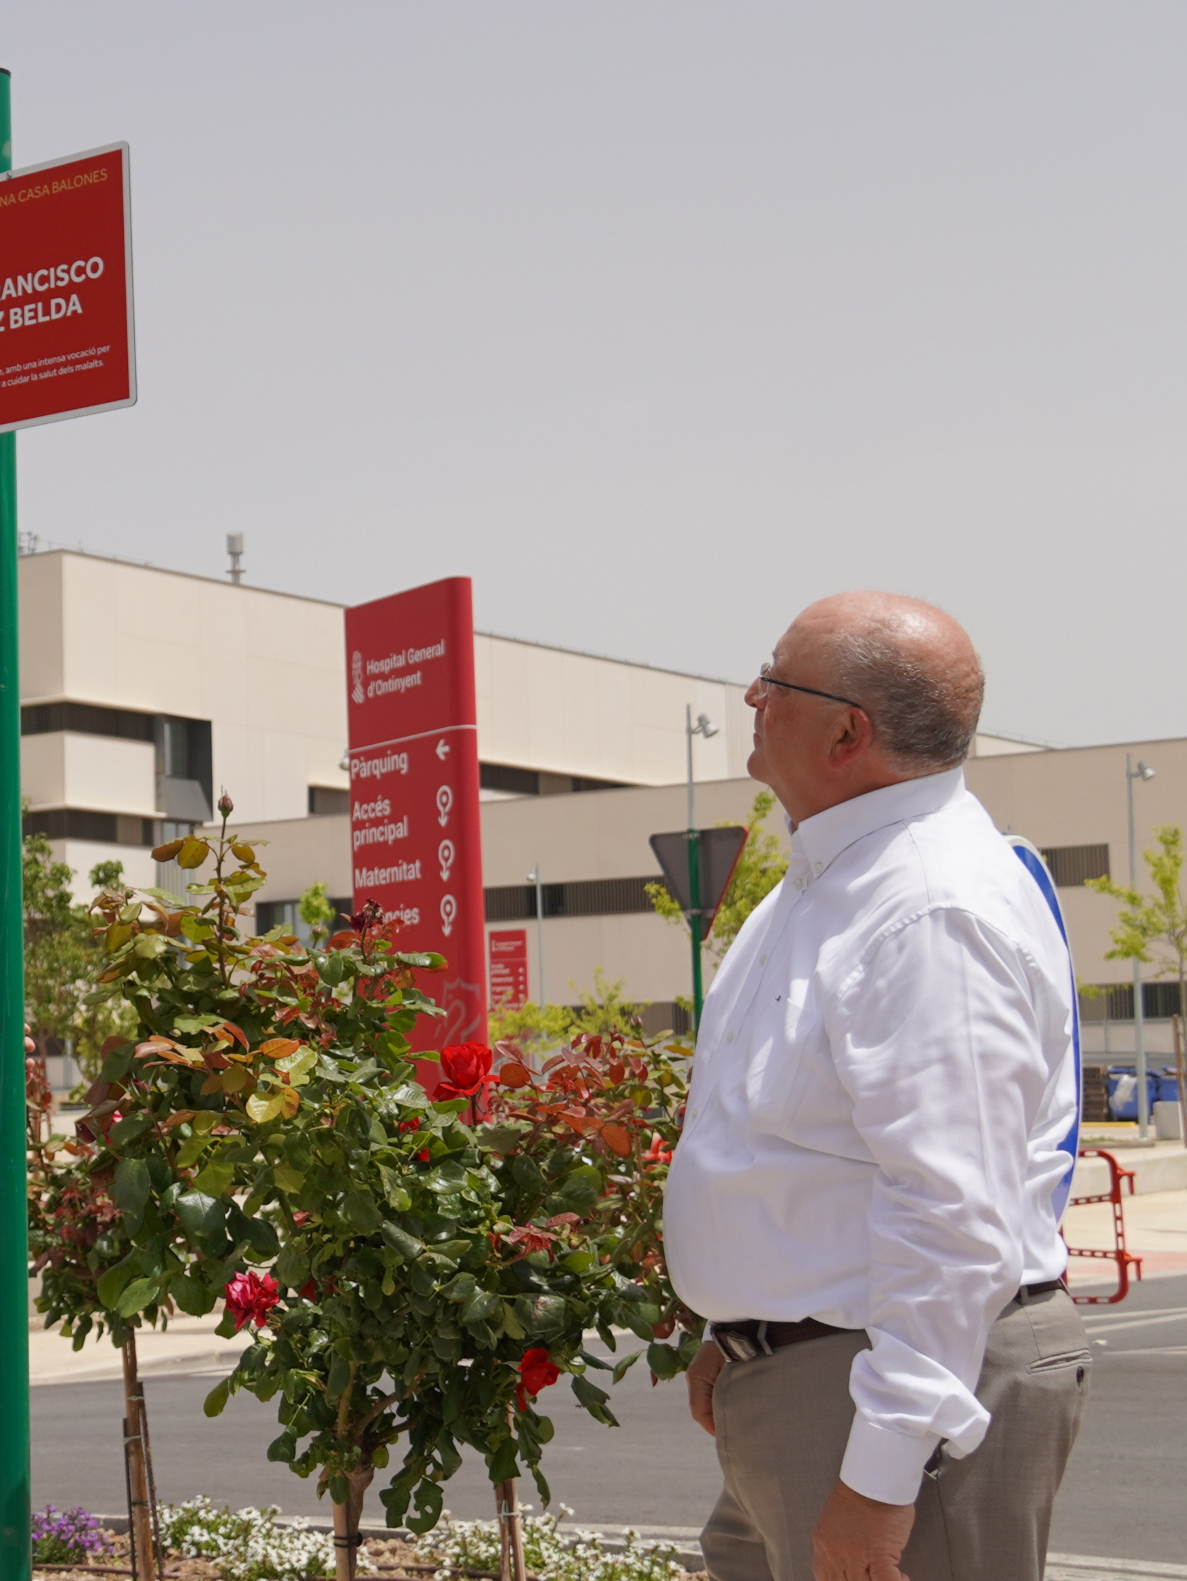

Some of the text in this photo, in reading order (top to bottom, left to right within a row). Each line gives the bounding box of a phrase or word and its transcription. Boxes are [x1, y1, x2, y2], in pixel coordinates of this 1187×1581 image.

[18, 184, 50, 202] CASA
[52, 168, 108, 194] BALONES
[9, 293, 83, 330] BELDA
[5, 363, 22, 374] amb
[23, 361, 37, 370] una
[37, 354, 66, 367] intensa
[66, 346, 96, 360] vocació
[97, 345, 111, 356] per
[1, 380, 7, 388] a
[7, 374, 30, 387] cuidar
[30, 373, 37, 381] la
[38, 368, 57, 379] salut
[58, 365, 74, 375] dels
[366, 638, 445, 675] Hospital General
[367, 670, 422, 698] d'Ontinyent
[351, 750, 408, 780] Pàrquing
[352, 794, 391, 821] Accés
[353, 815, 408, 852] principal
[354, 859, 421, 889] Maternitat
